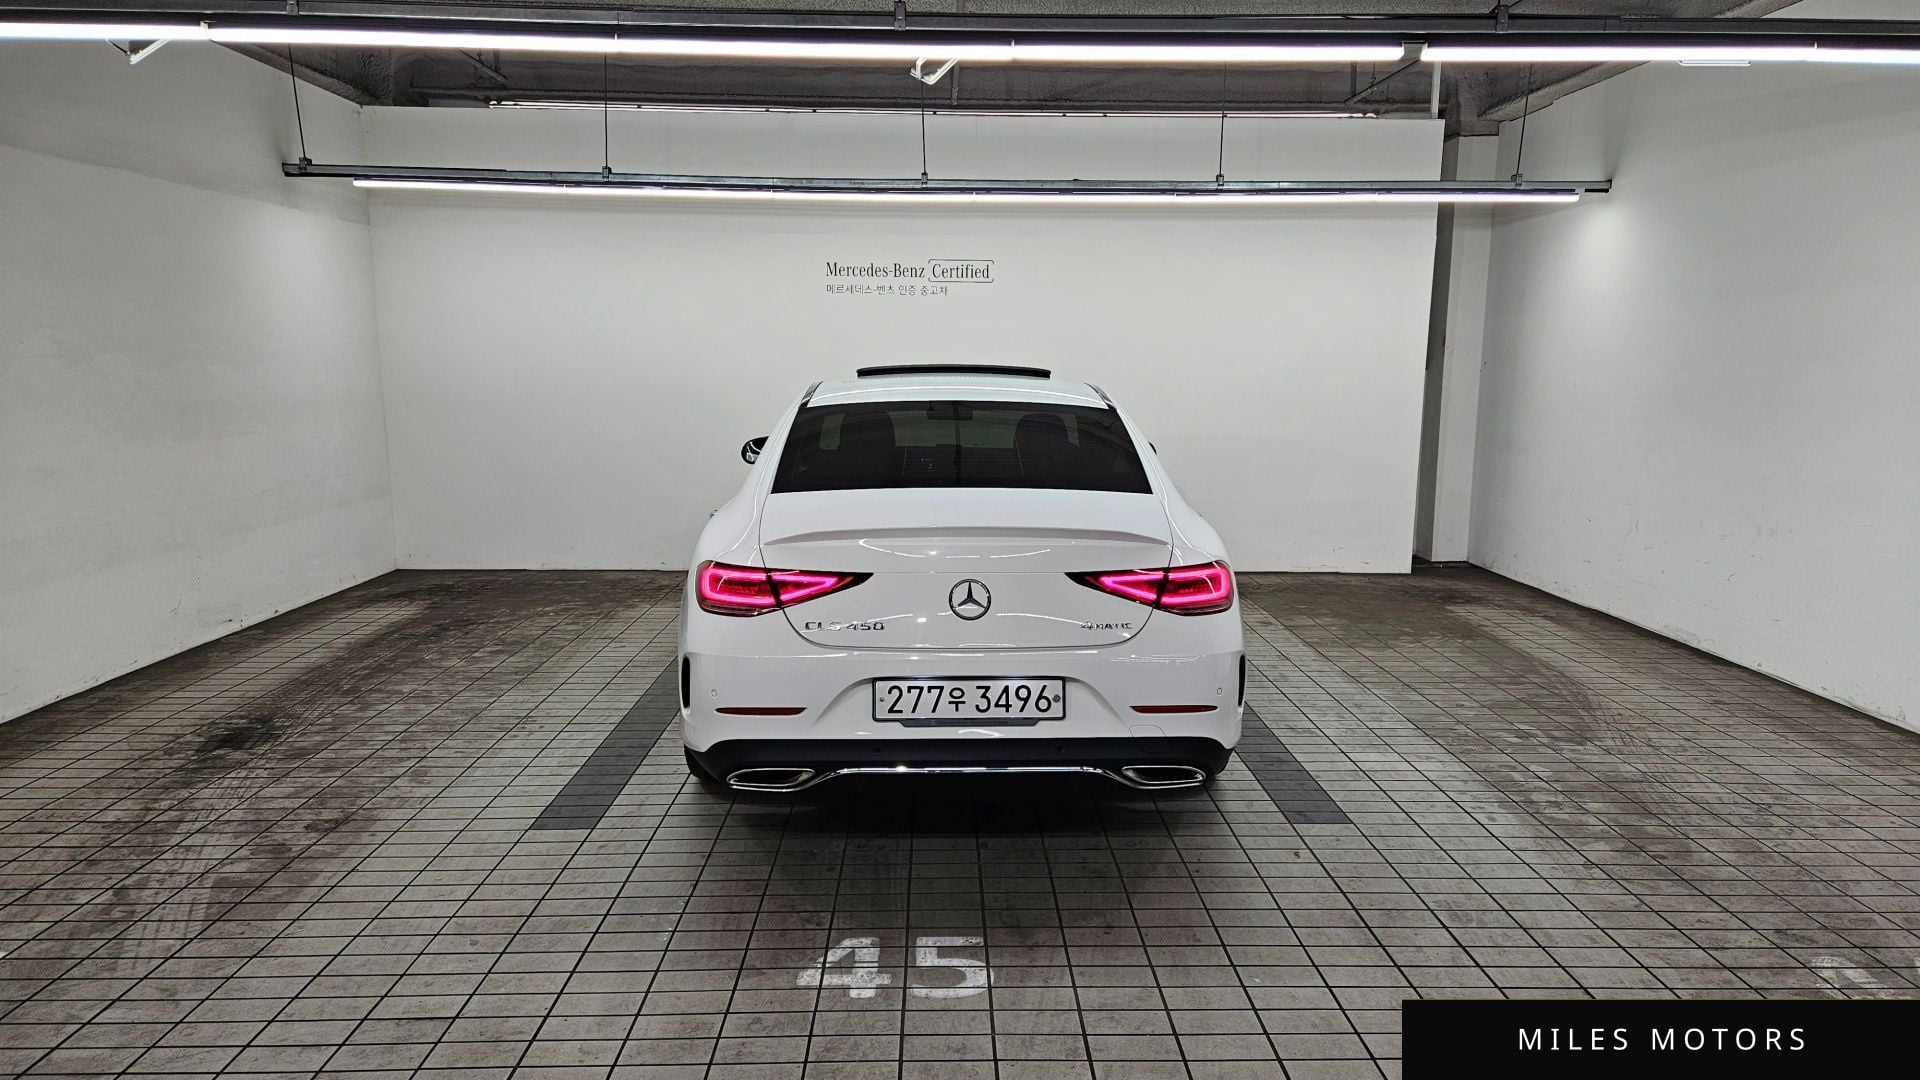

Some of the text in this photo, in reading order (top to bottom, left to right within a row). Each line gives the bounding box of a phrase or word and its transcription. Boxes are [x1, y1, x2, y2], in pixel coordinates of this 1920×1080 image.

[826, 261, 990, 279] Mercedes-Benz Certified
[826, 284, 948, 297] 메르세데스-벤츠 인증 중고차
[805, 621, 885, 631] CLS 450
[887, 684, 1052, 714] 277우 3496
[796, 936, 995, 999] 45
